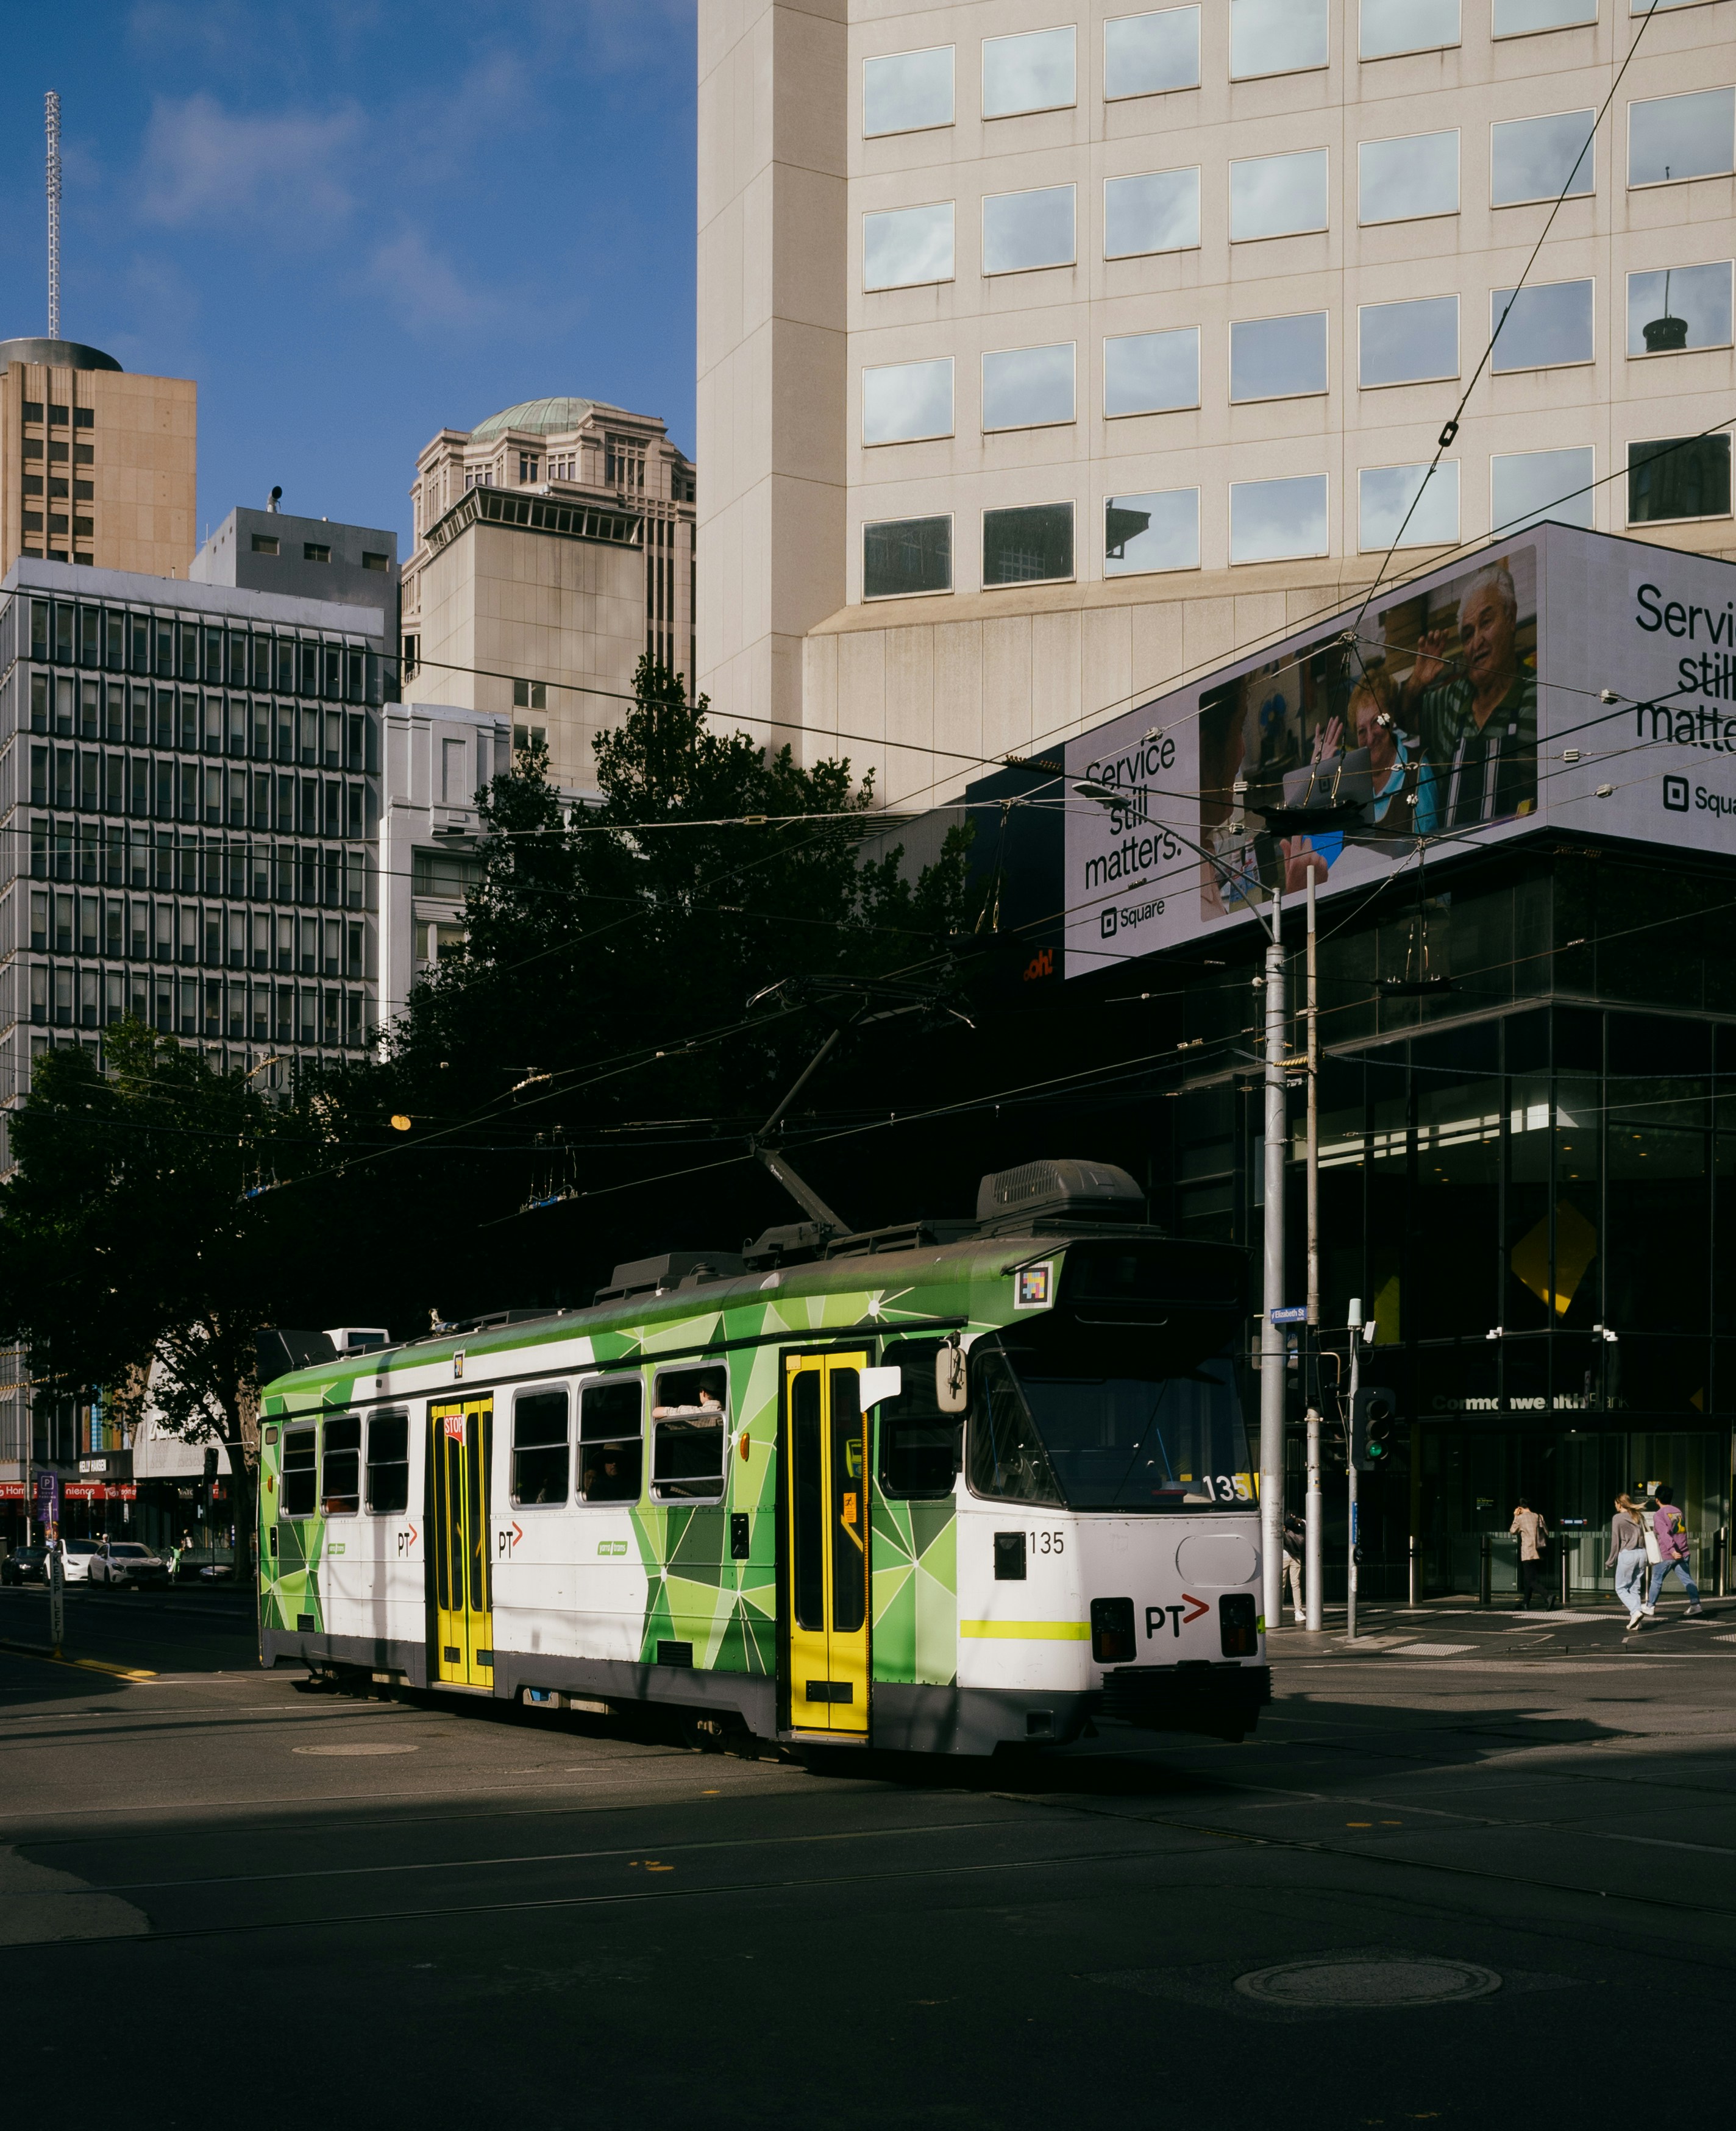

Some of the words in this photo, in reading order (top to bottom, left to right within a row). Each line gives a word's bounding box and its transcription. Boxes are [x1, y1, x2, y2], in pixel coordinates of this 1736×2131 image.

[1636, 583, 1736, 647] Servi
[1086, 737, 1175, 785] Service
[1110, 784, 1148, 836] still
[1086, 831, 1182, 890] matters.
[1120, 898, 1165, 931] Square
[1275, 1309, 1297, 1318] Elizabeth
[1298, 1308, 1304, 1317] St
[445, 1417, 462, 1434] STOP
[1203, 1475, 1249, 1501] 135
[398, 1532, 410, 1557] PT
[499, 1531, 513, 1558] PT
[1029, 1532, 1064, 1554] 135
[1146, 1605, 1185, 1639] PT
